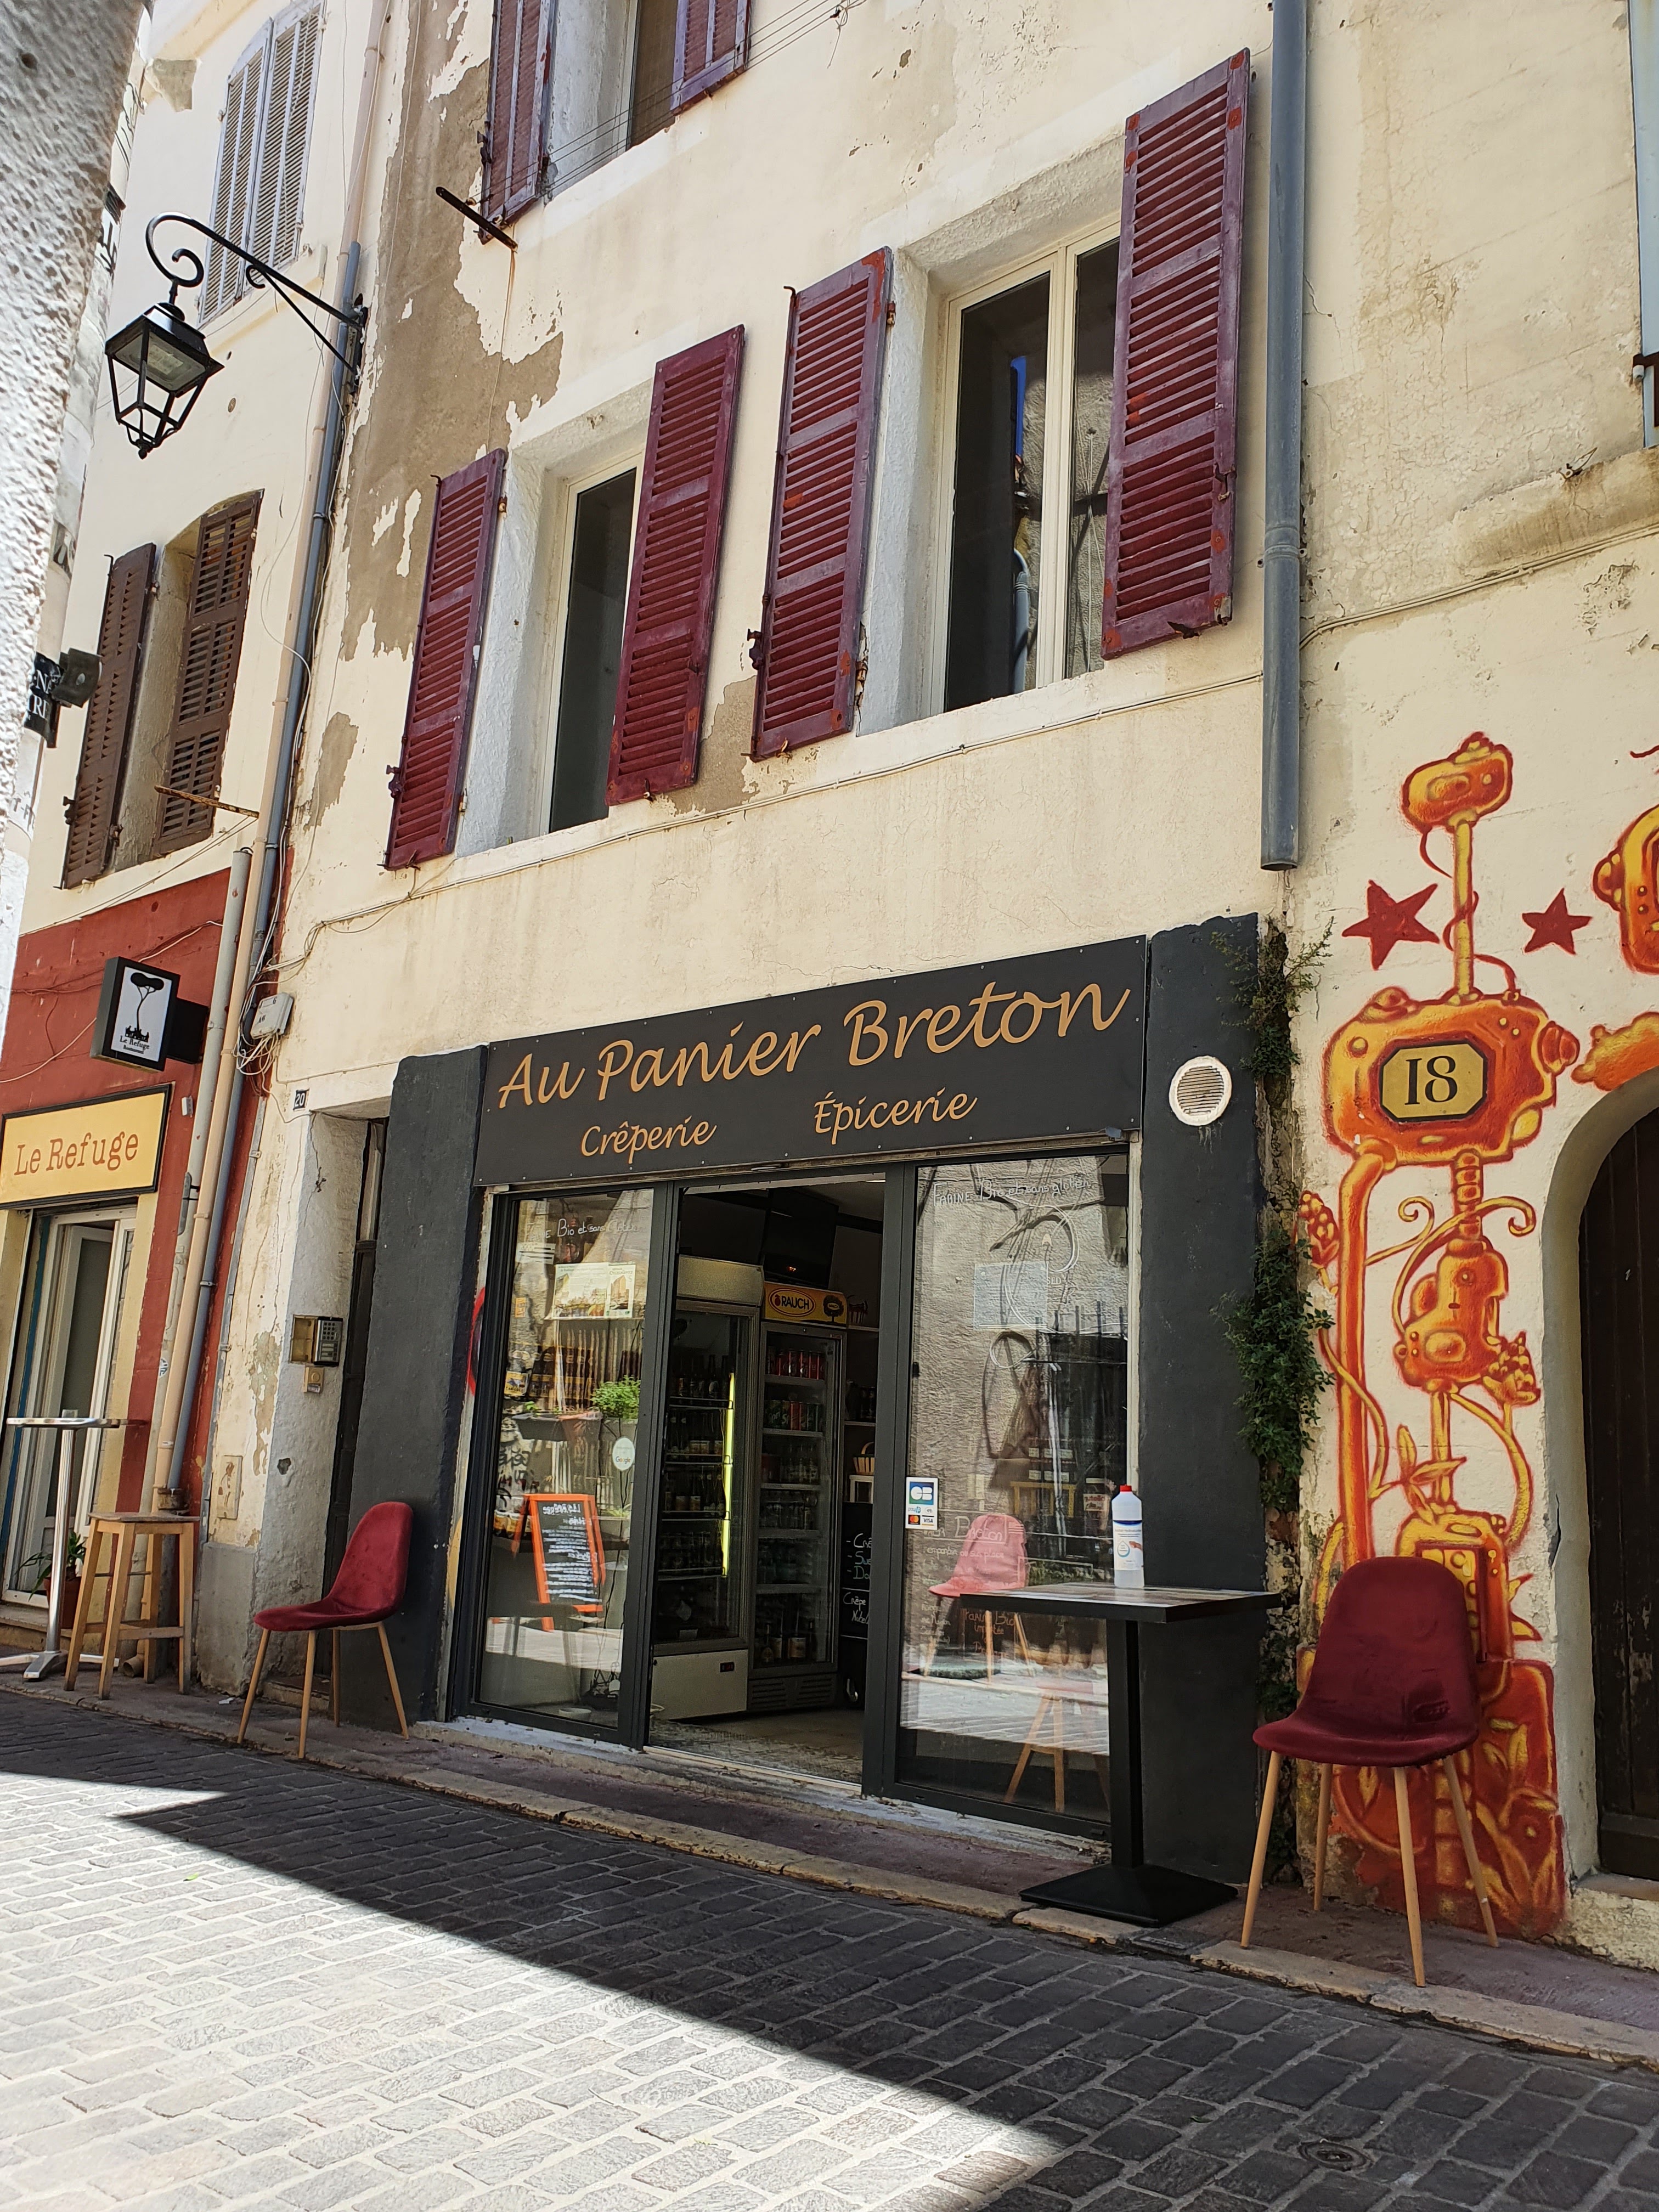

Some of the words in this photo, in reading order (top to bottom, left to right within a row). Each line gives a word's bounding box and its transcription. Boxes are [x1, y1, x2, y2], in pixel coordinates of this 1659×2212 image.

[129, 1039, 150, 1051] Refuge
[499, 1053, 585, 1108] Au
[597, 1022, 822, 1102] Panier
[843, 981, 1132, 1067] Breton
[1404, 1056, 1458, 1105] 18
[295, 1093, 306, 1107] 20
[581, 1119, 717, 1164] Crêperie
[814, 1086, 978, 1144] Épicerie
[14, 1144, 40, 1176] Le
[46, 1131, 139, 1172] Refuge
[557, 1218, 575, 1237] Bio
[578, 1221, 588, 1234] et
[589, 1223, 605, 1233] sans
[781, 1295, 810, 1310] RAUCH
